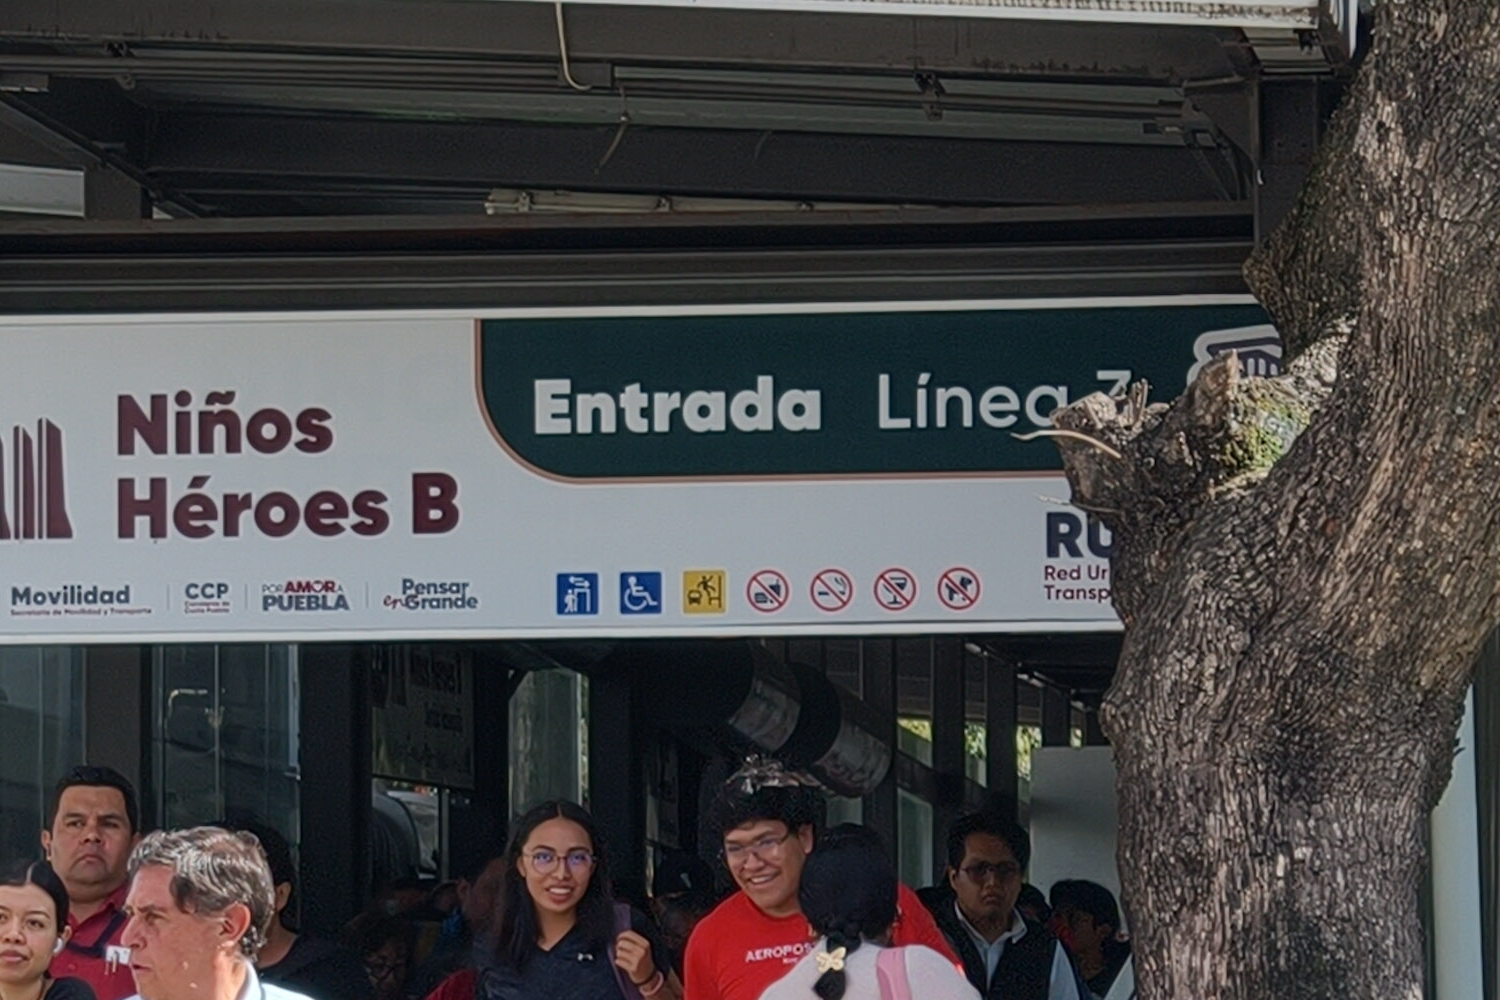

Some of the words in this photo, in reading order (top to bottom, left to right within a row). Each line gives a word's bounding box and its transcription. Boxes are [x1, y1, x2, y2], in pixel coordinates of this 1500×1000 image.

[534, 375, 821, 434] Entrada
[878, 372, 1068, 428] Línea
[118, 390, 334, 456] Niños
[118, 475, 390, 539] Héroes
[412, 472, 460, 535] B
[1046, 511, 1116, 559] RU
[1044, 564, 1081, 581] Red
[1088, 564, 1108, 580] Ur
[11, 585, 130, 606] Movilidad
[185, 583, 229, 600] CCP
[284, 580, 336, 593] AMOR
[402, 578, 470, 595] Pensar
[1044, 584, 1112, 604] Transp
[263, 595, 349, 611] PUEBLA
[383, 594, 407, 610] en
[405, 592, 479, 611] Grande
[745, 943, 816, 963] AEROPOS
